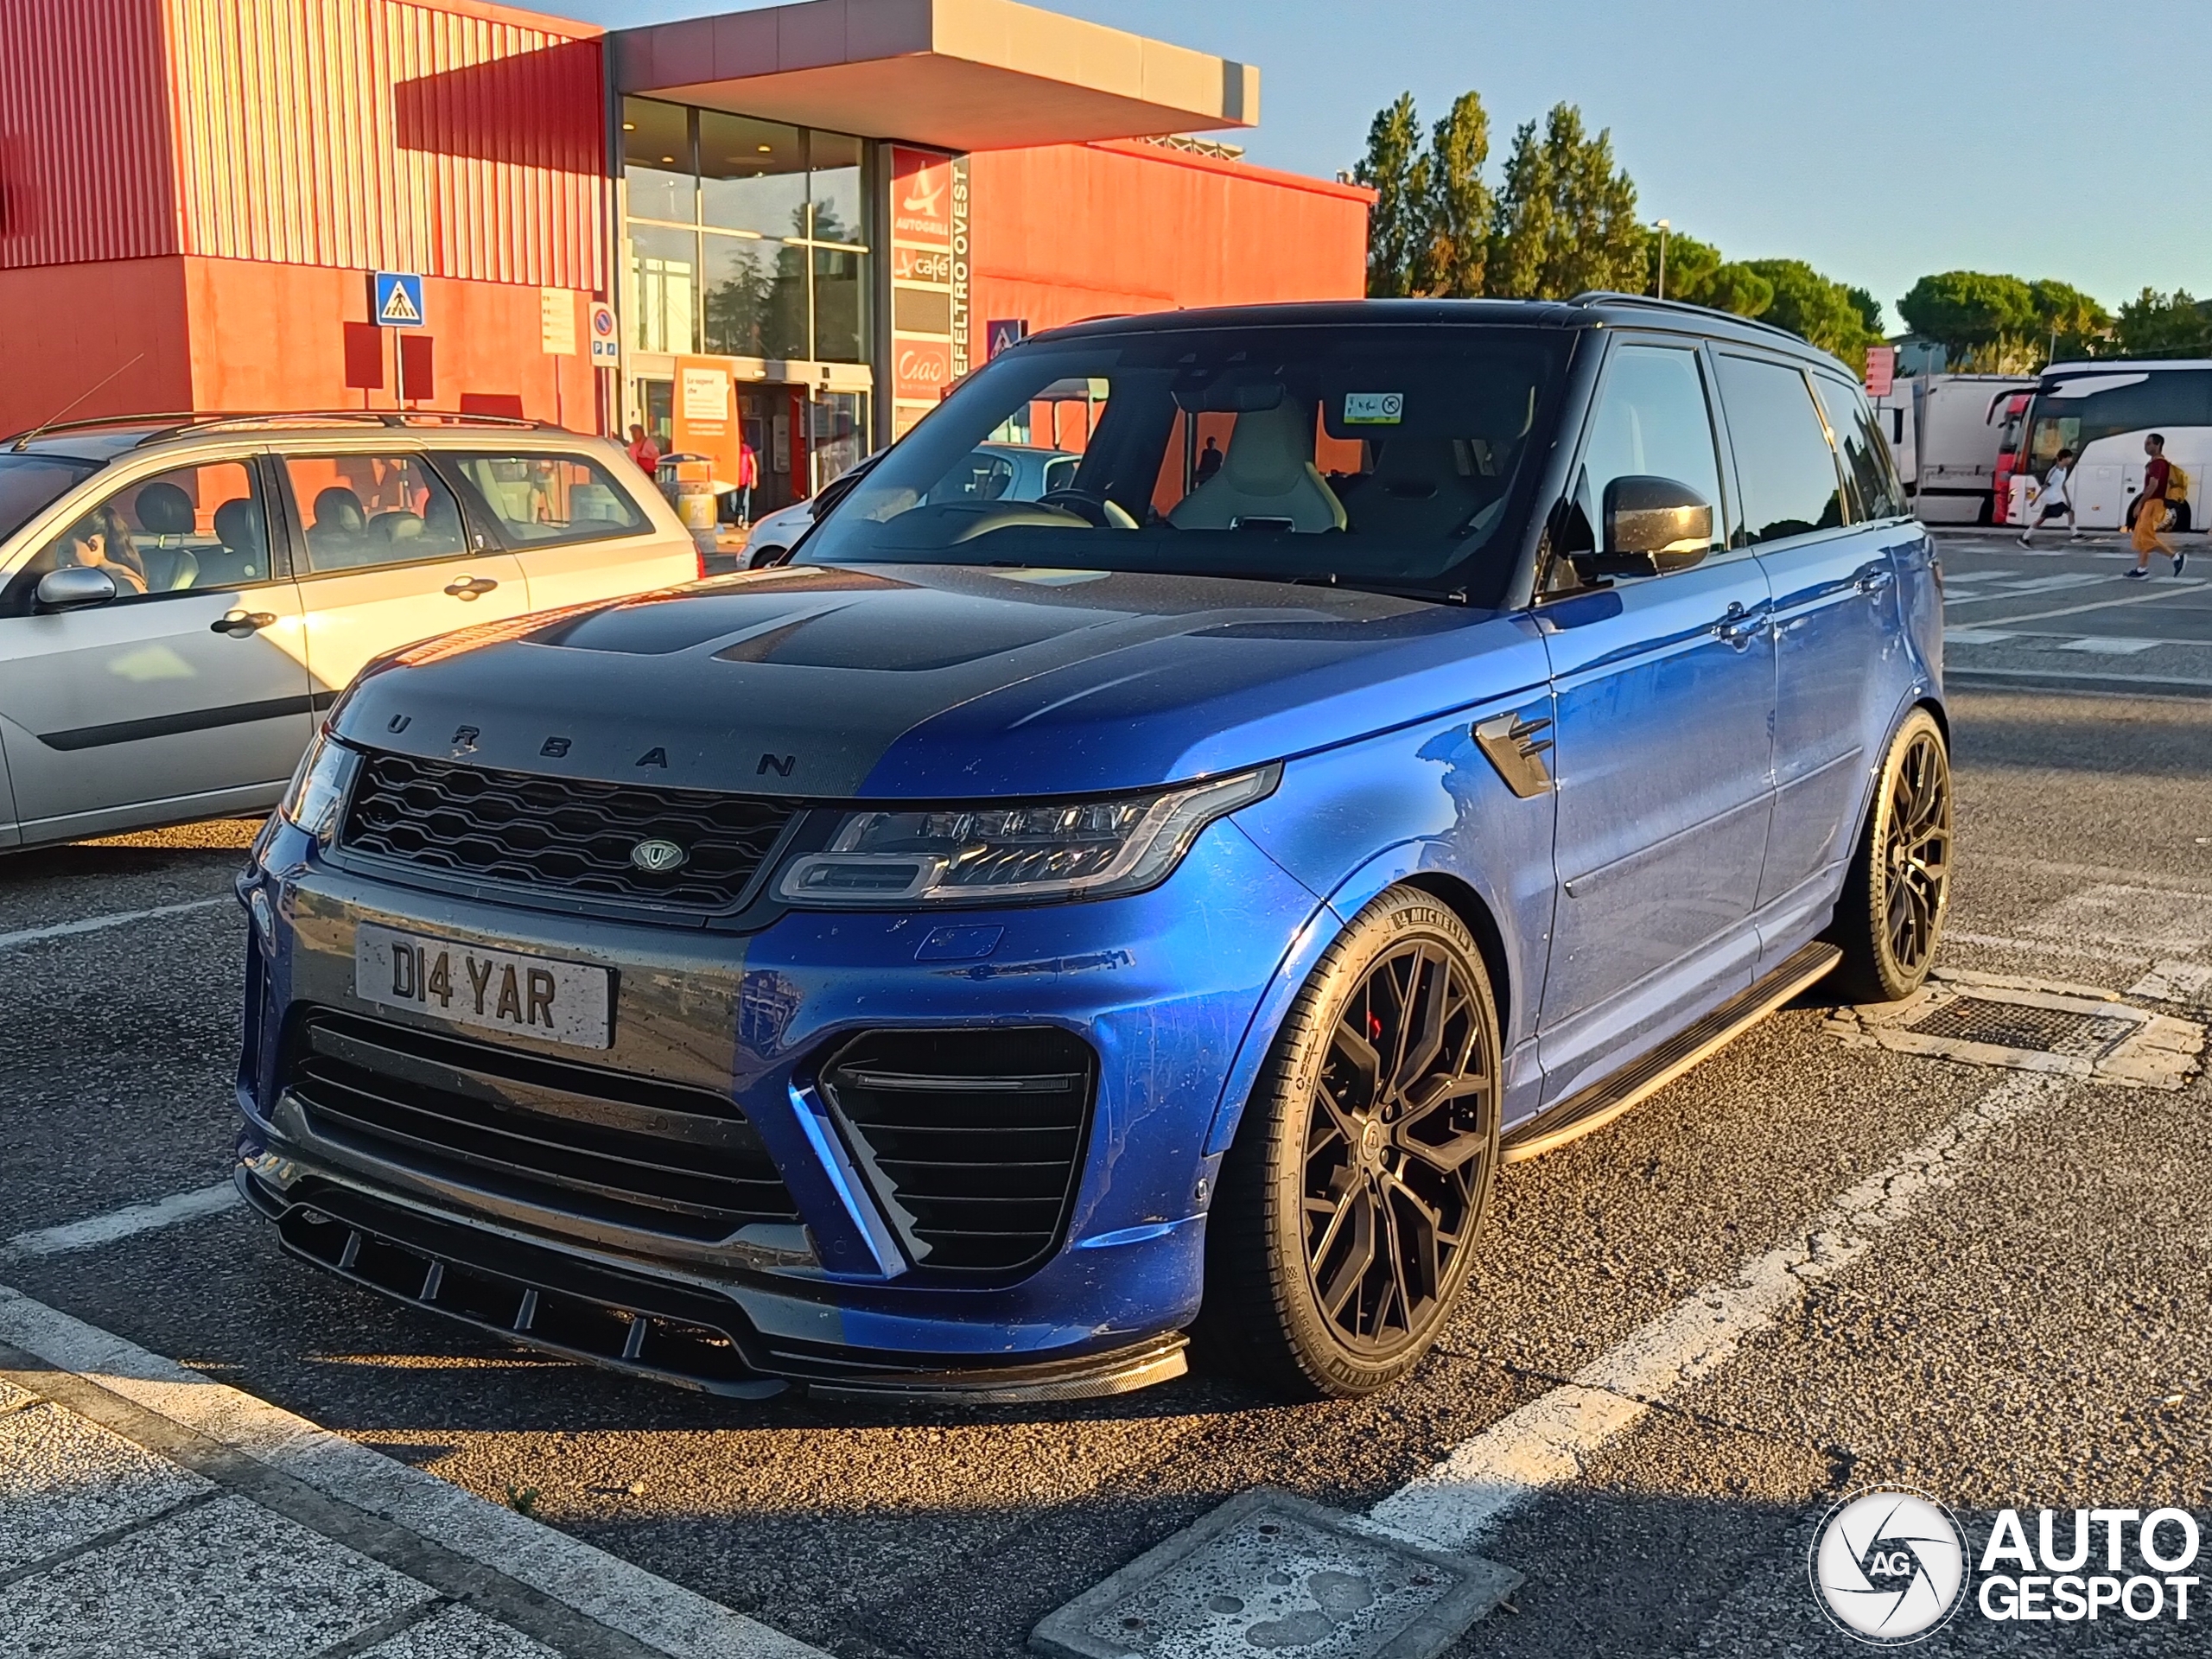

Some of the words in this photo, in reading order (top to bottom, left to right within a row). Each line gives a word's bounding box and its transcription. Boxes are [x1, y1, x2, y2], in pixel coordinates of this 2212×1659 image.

[895, 217, 949, 236] AUTOGRILL
[953, 166, 968, 255] OVEST
[914, 255, 950, 282] café
[953, 262, 968, 379] EFELTRO
[899, 350, 944, 382] Ciao
[387, 714, 796, 777] URBAN
[1411, 908, 1469, 948] MICHELIN
[391, 940, 454, 1008] D14
[465, 956, 556, 1029] YAR
[1309, 1340, 1327, 1361] PILOT
[1332, 1362, 1400, 1387] MICHELIN
